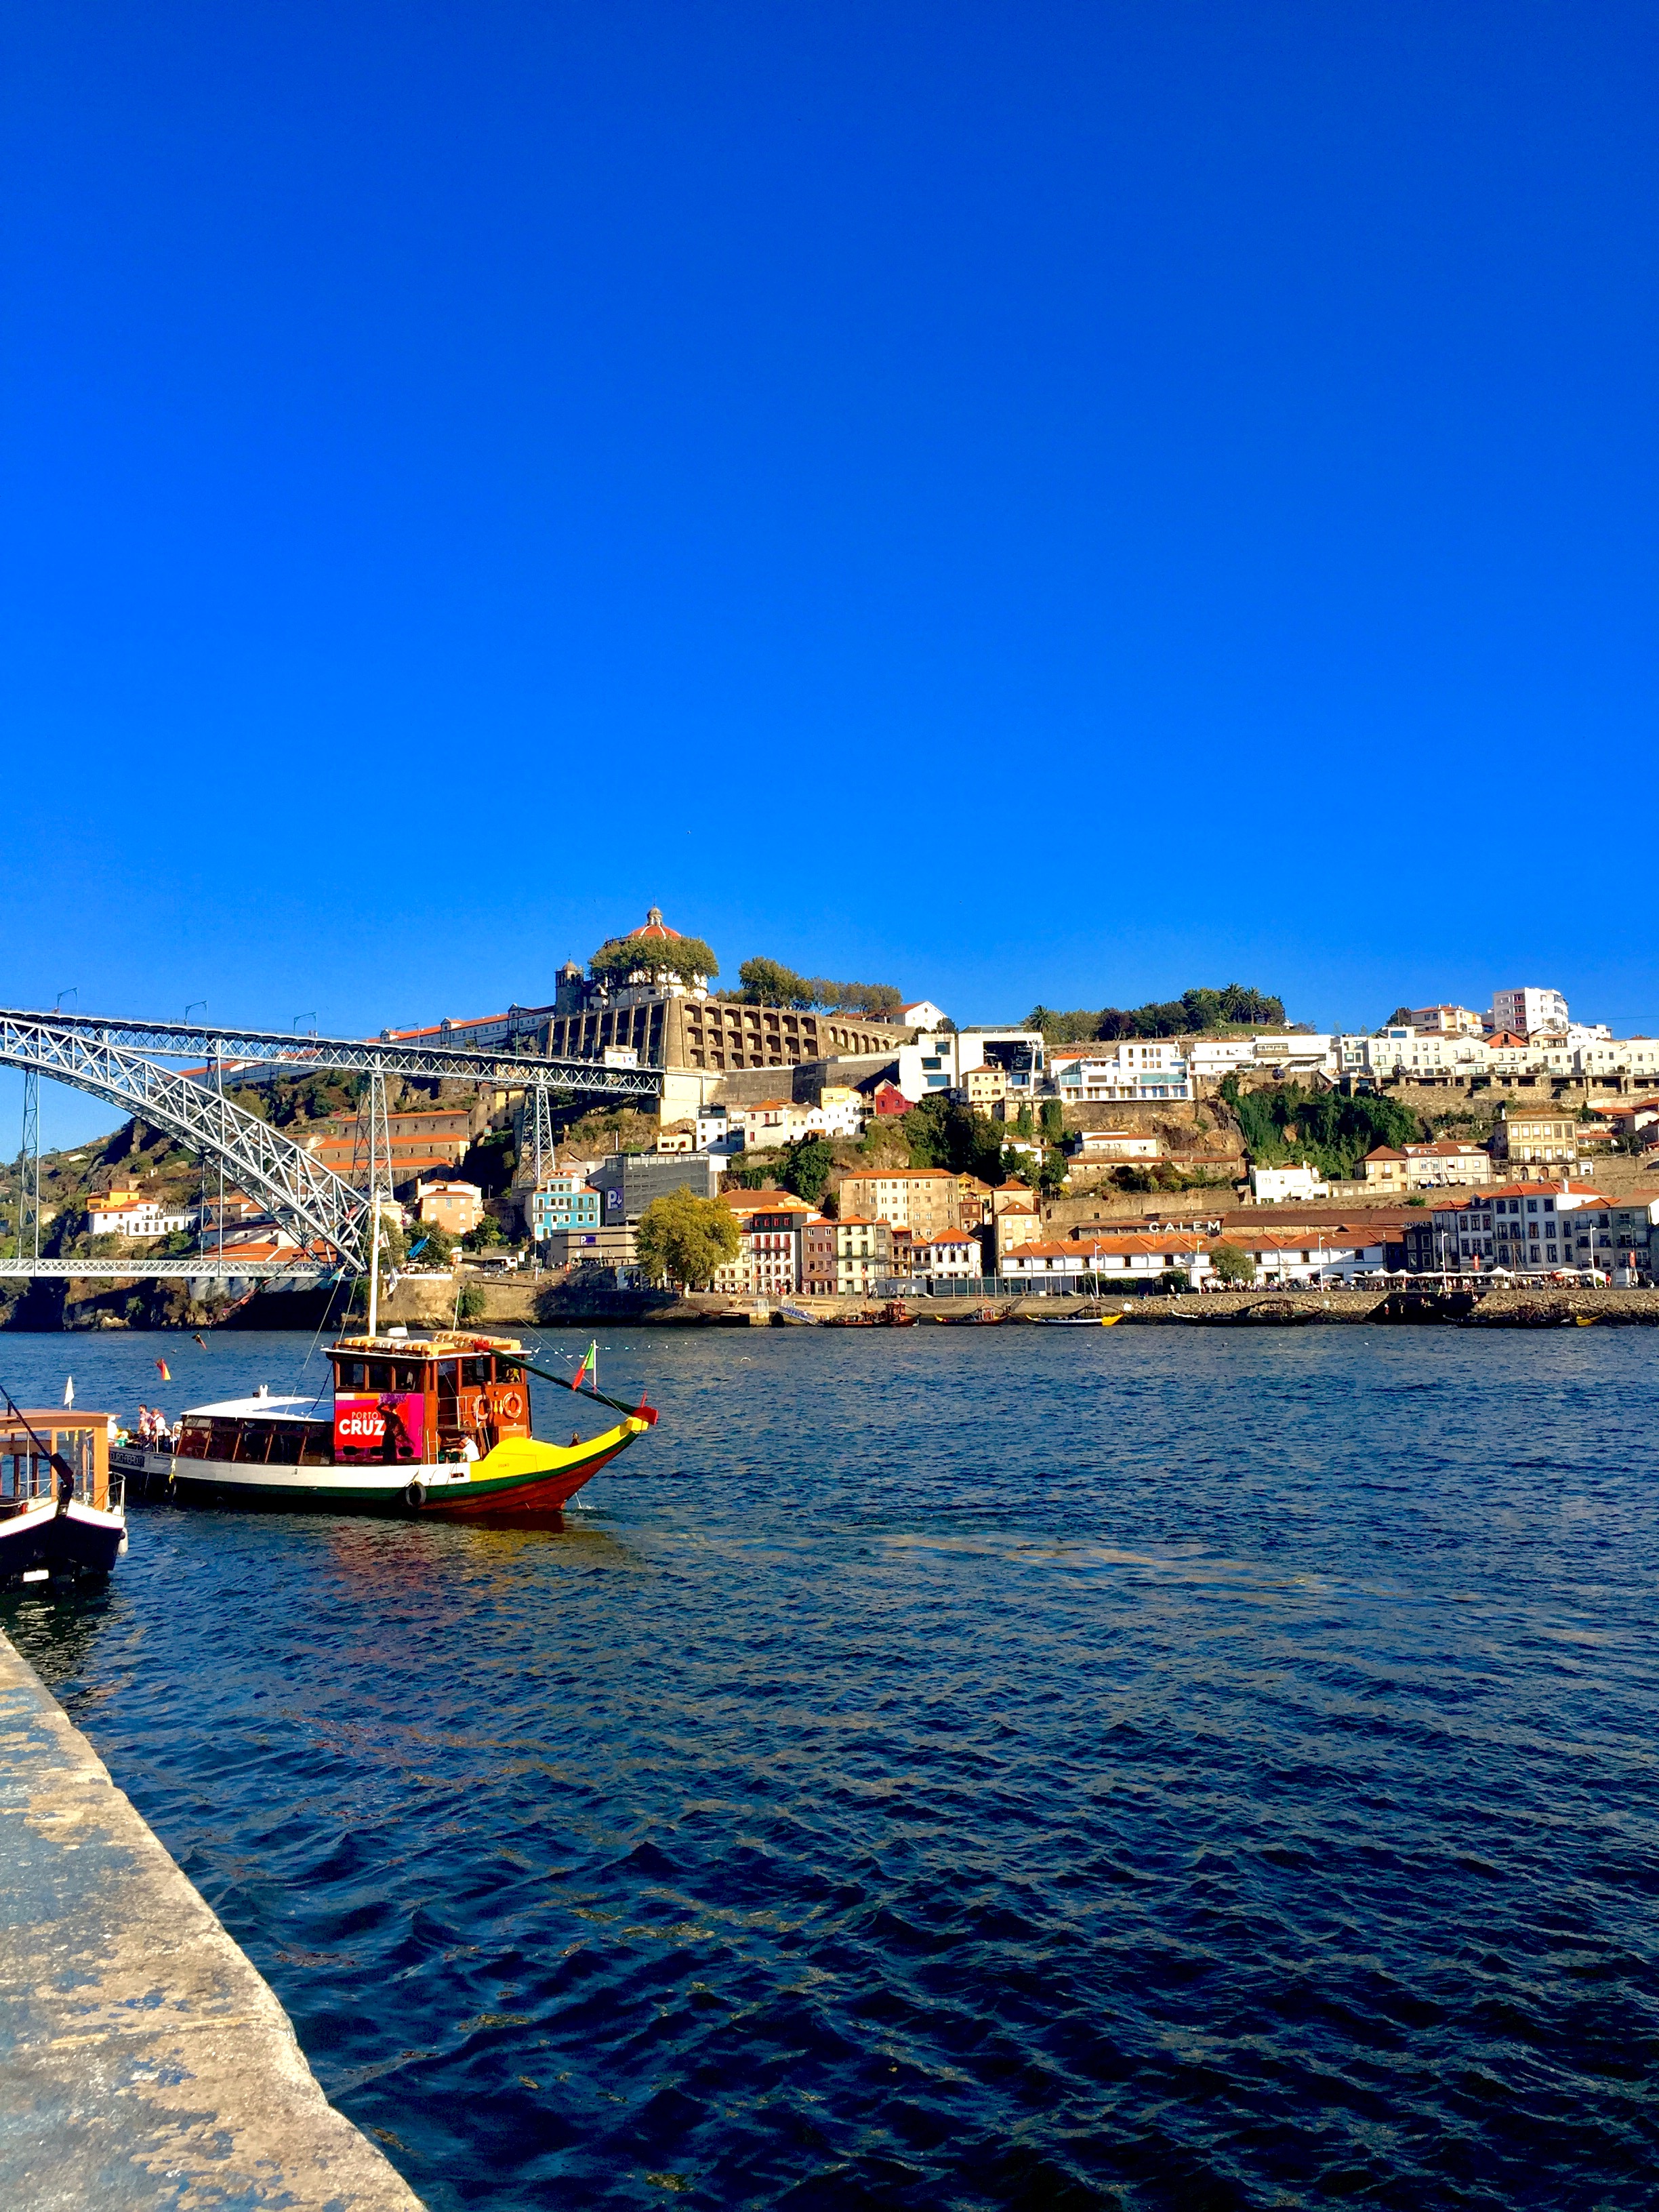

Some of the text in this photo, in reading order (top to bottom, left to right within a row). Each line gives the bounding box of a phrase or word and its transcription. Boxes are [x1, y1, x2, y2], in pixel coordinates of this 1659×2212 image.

[607, 1190, 617, 1210] P
[580, 1235, 587, 1245] P
[935, 1242, 970, 1251] SPORT
[352, 1412, 378, 1420] PORTO
[339, 1419, 385, 1435] CRUZ
